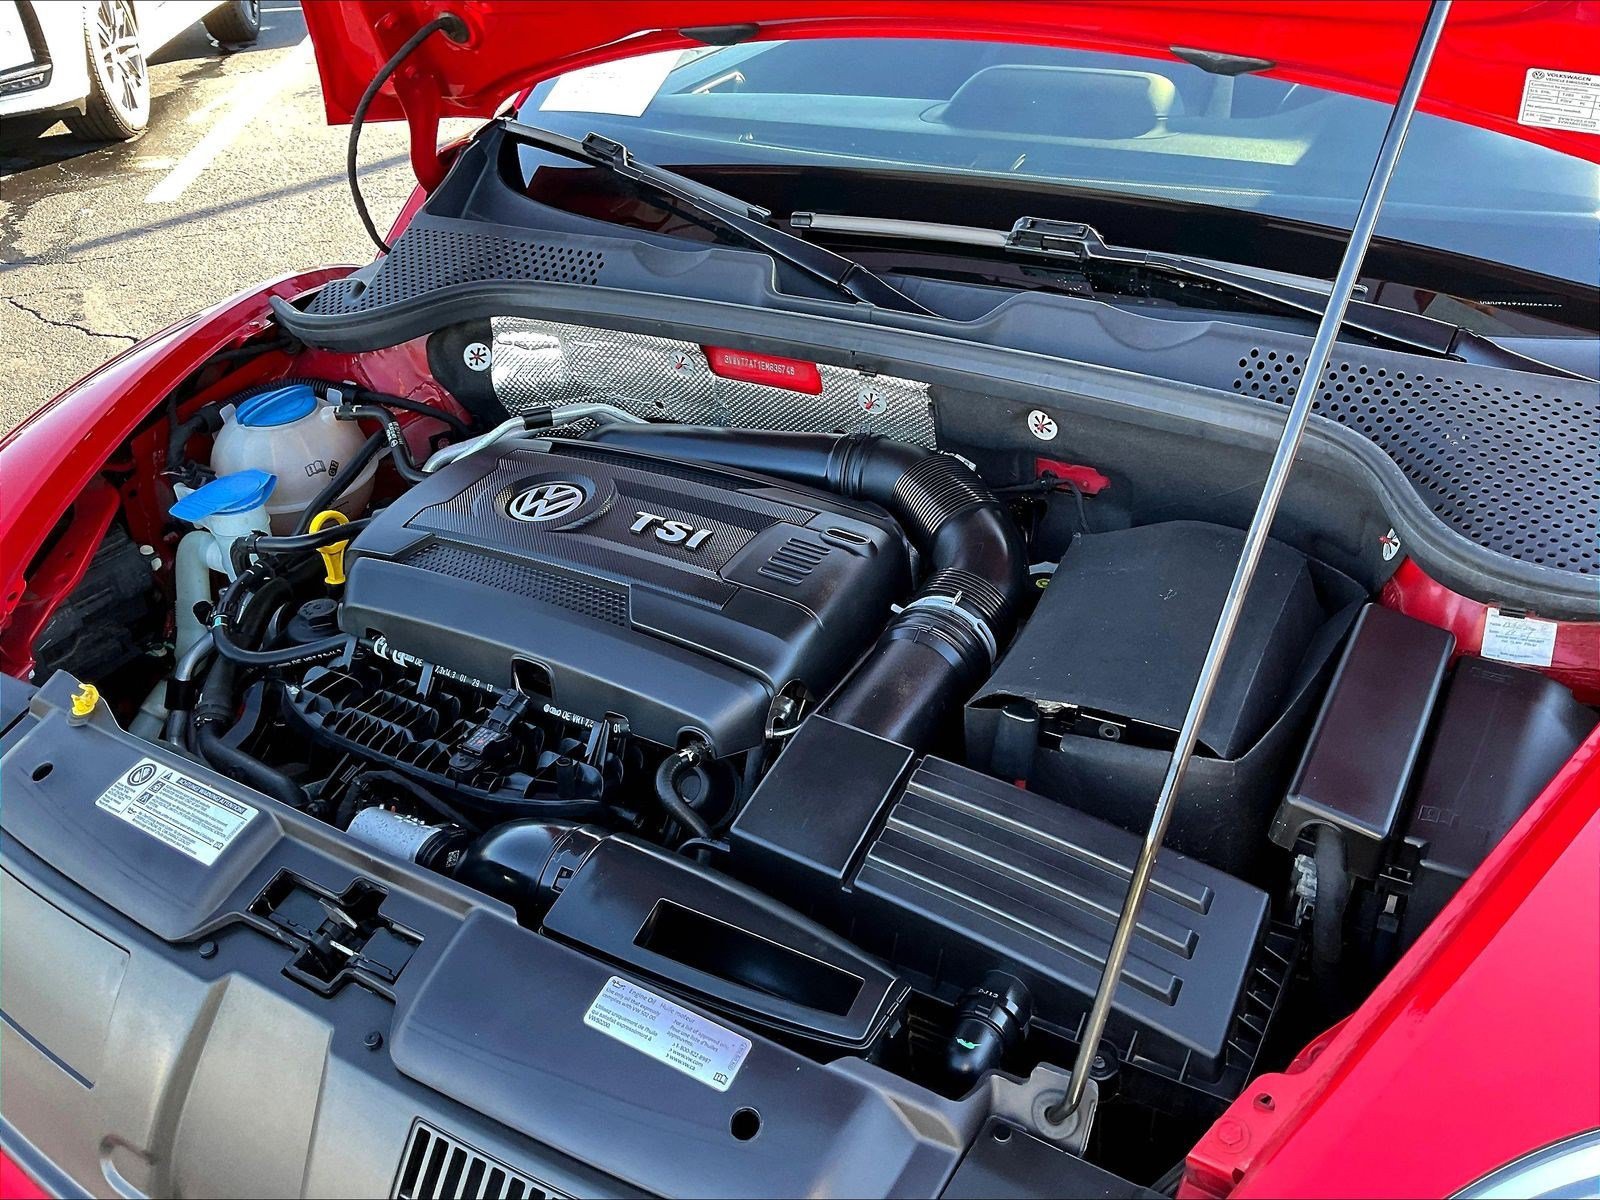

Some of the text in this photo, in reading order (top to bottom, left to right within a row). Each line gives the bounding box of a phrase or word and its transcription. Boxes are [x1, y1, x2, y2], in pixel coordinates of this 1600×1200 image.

[1547, 72, 1592, 82] VOLKSWAGEN
[630, 511, 713, 550] TSI
[471, 678, 481, 688] 29
[486, 683, 494, 693] 13
[620, 1001, 632, 1009] with
[627, 988, 648, 1001] Engine
[646, 996, 657, 1005] Oil
[674, 1010, 696, 1023] moteur
[629, 998, 640, 1006] that
[668, 1054, 696, 1071] www.vw.ca
